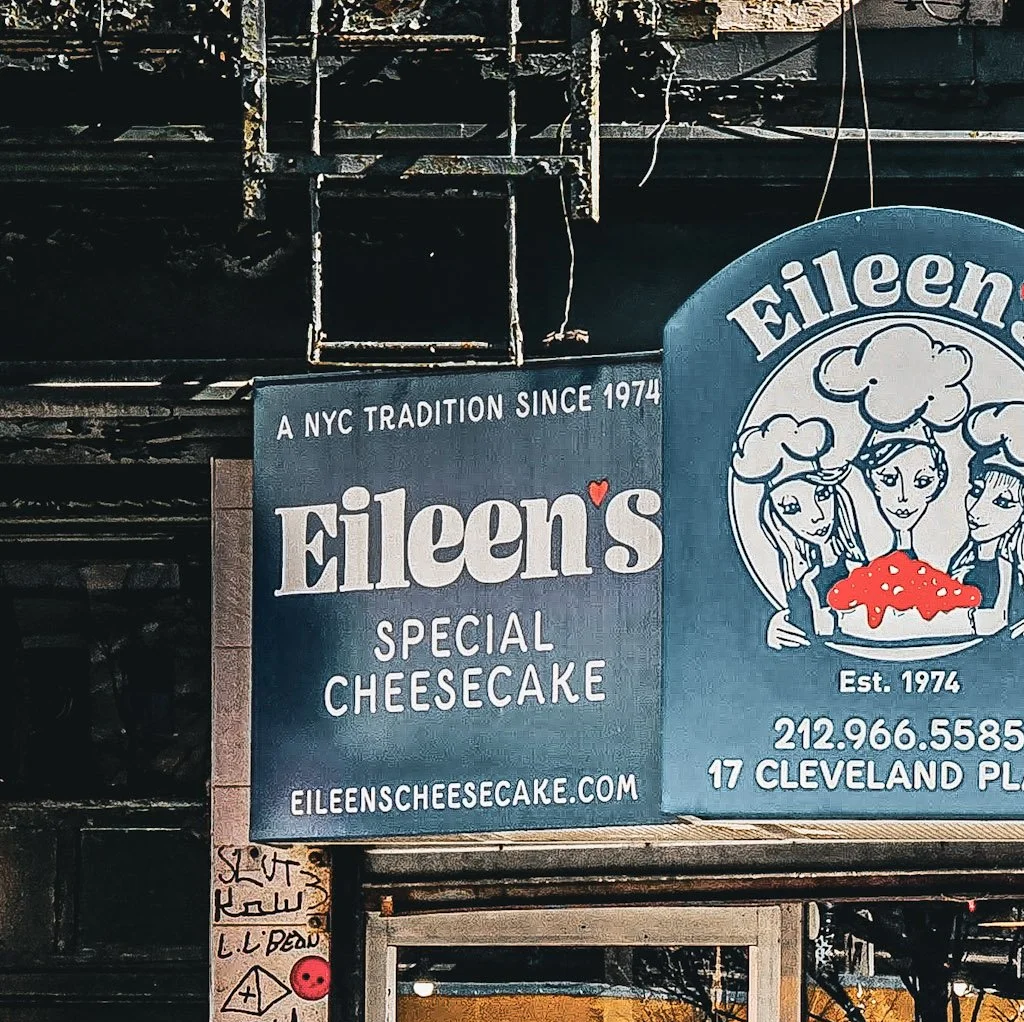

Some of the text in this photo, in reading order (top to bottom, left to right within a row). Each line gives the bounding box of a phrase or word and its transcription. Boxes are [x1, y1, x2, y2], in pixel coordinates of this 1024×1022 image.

[276, 379, 661, 441] A NYC TRADITION SINCE 1974
[273, 479, 664, 598] Eileen's
[372, 610, 554, 662] SPECIAL
[324, 659, 607, 718] CHEESECAKE
[838, 669, 962, 694] Est. 1974
[290, 773, 639, 817] EILEENSCHEESECAKE.COM
[707, 762, 743, 790] 17
[755, 760, 964, 791] CLEVELAND
